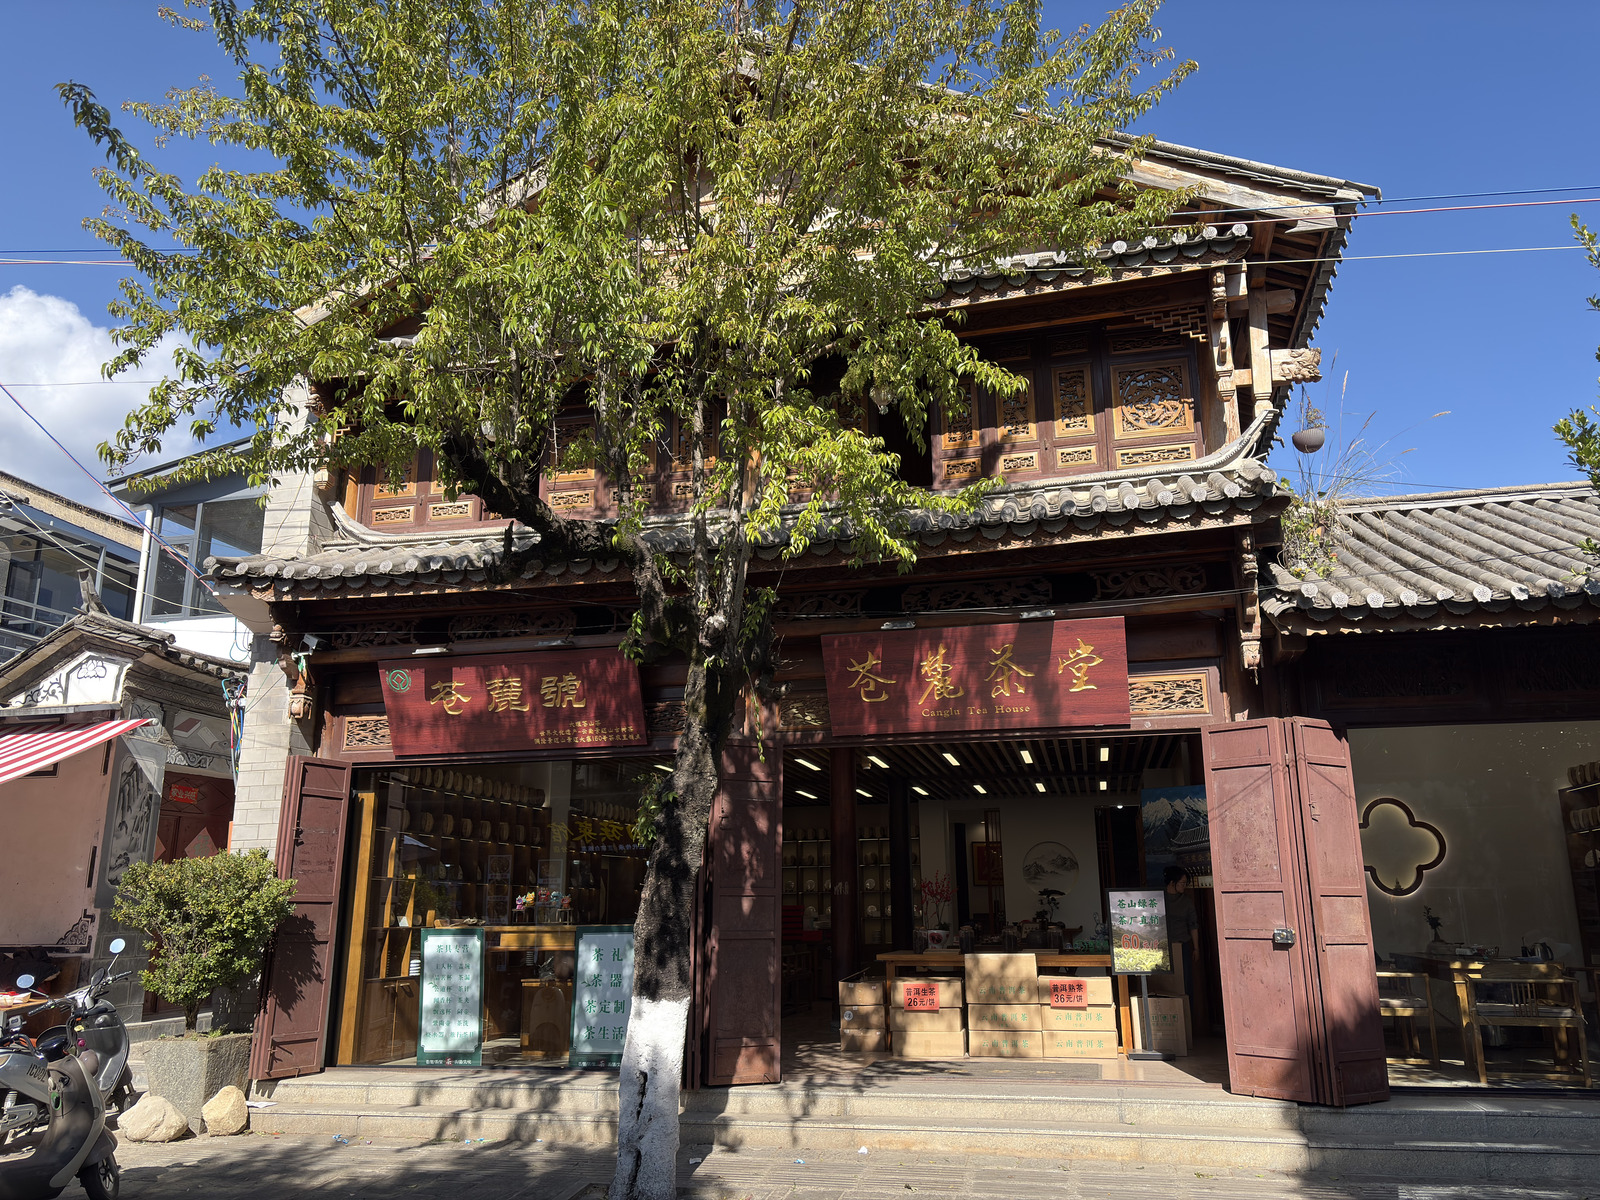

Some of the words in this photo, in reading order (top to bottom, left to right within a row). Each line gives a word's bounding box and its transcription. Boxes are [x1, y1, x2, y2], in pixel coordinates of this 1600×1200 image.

[921, 707, 960, 718] Canglu
[967, 706, 988, 715] Tea
[994, 705, 1031, 714] House
[1117, 898, 1158, 909] 苍山绿茶
[1118, 915, 1159, 925] 茶厂直销
[436, 944, 469, 954] 茶具专营
[592, 947, 624, 962] 茶礼
[591, 973, 622, 988] 茶器
[905, 987, 936, 996] 普洱生茶
[979, 985, 1026, 995] 云南普洱茶
[1052, 983, 1084, 993] 普洱熟茶
[907, 997, 936, 1007] 26元/饼
[1054, 994, 1083, 1004] 36元/饼
[585, 999, 626, 1014] 茶定制
[981, 1013, 1028, 1022] 云南普洱茶
[1055, 1012, 1103, 1022] 云南普洱茶
[584, 1025, 625, 1040] 茶生活
[982, 1039, 1029, 1048] 云南普洱茶
[1056, 1039, 1104, 1049] 云南普洱茶
